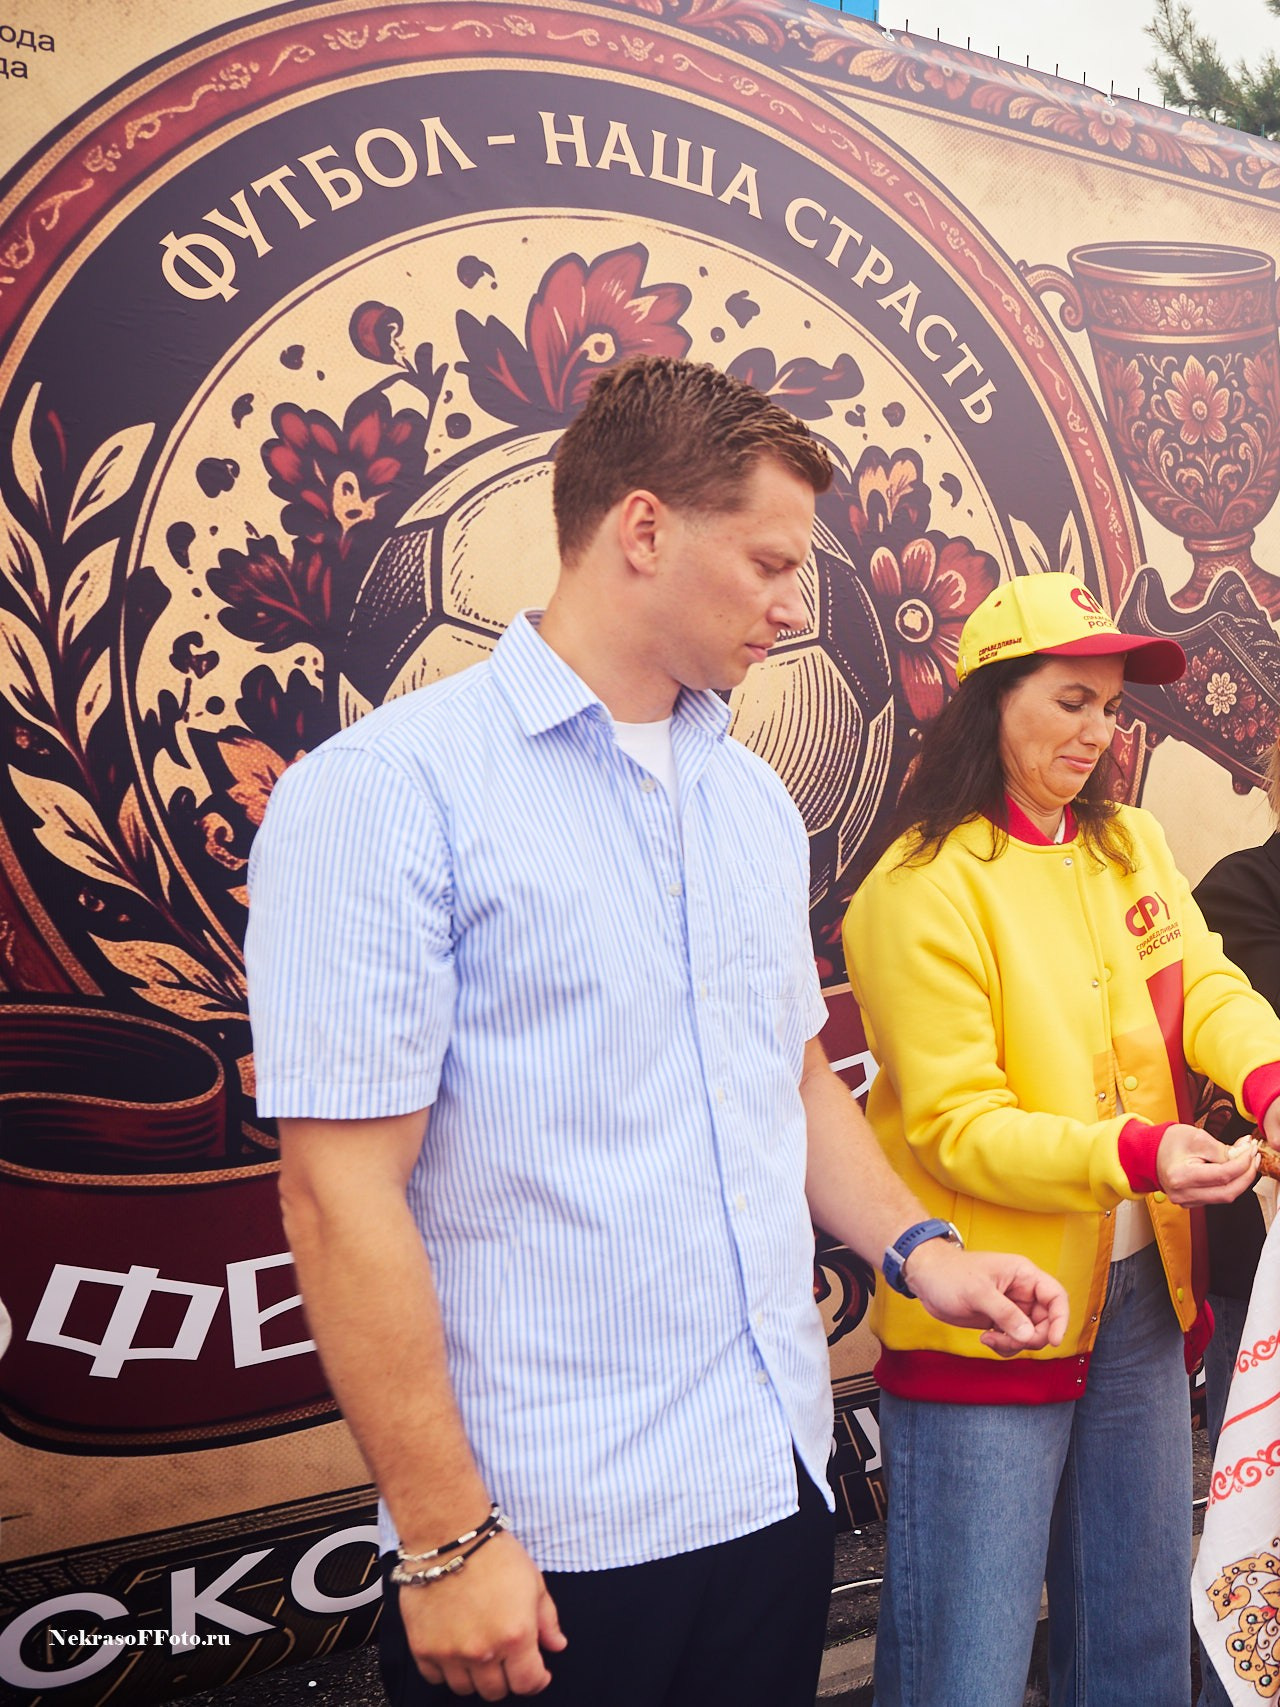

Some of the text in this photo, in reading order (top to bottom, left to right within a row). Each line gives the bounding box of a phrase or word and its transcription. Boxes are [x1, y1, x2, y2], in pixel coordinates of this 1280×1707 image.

[0, 25, 55, 53] ода
[0, 57, 28, 80] да
[160, 111, 995, 426] ФУТБОЛ - НАША СТРАСТЬ
[1138, 929, 1182, 960] РОССИЯ
